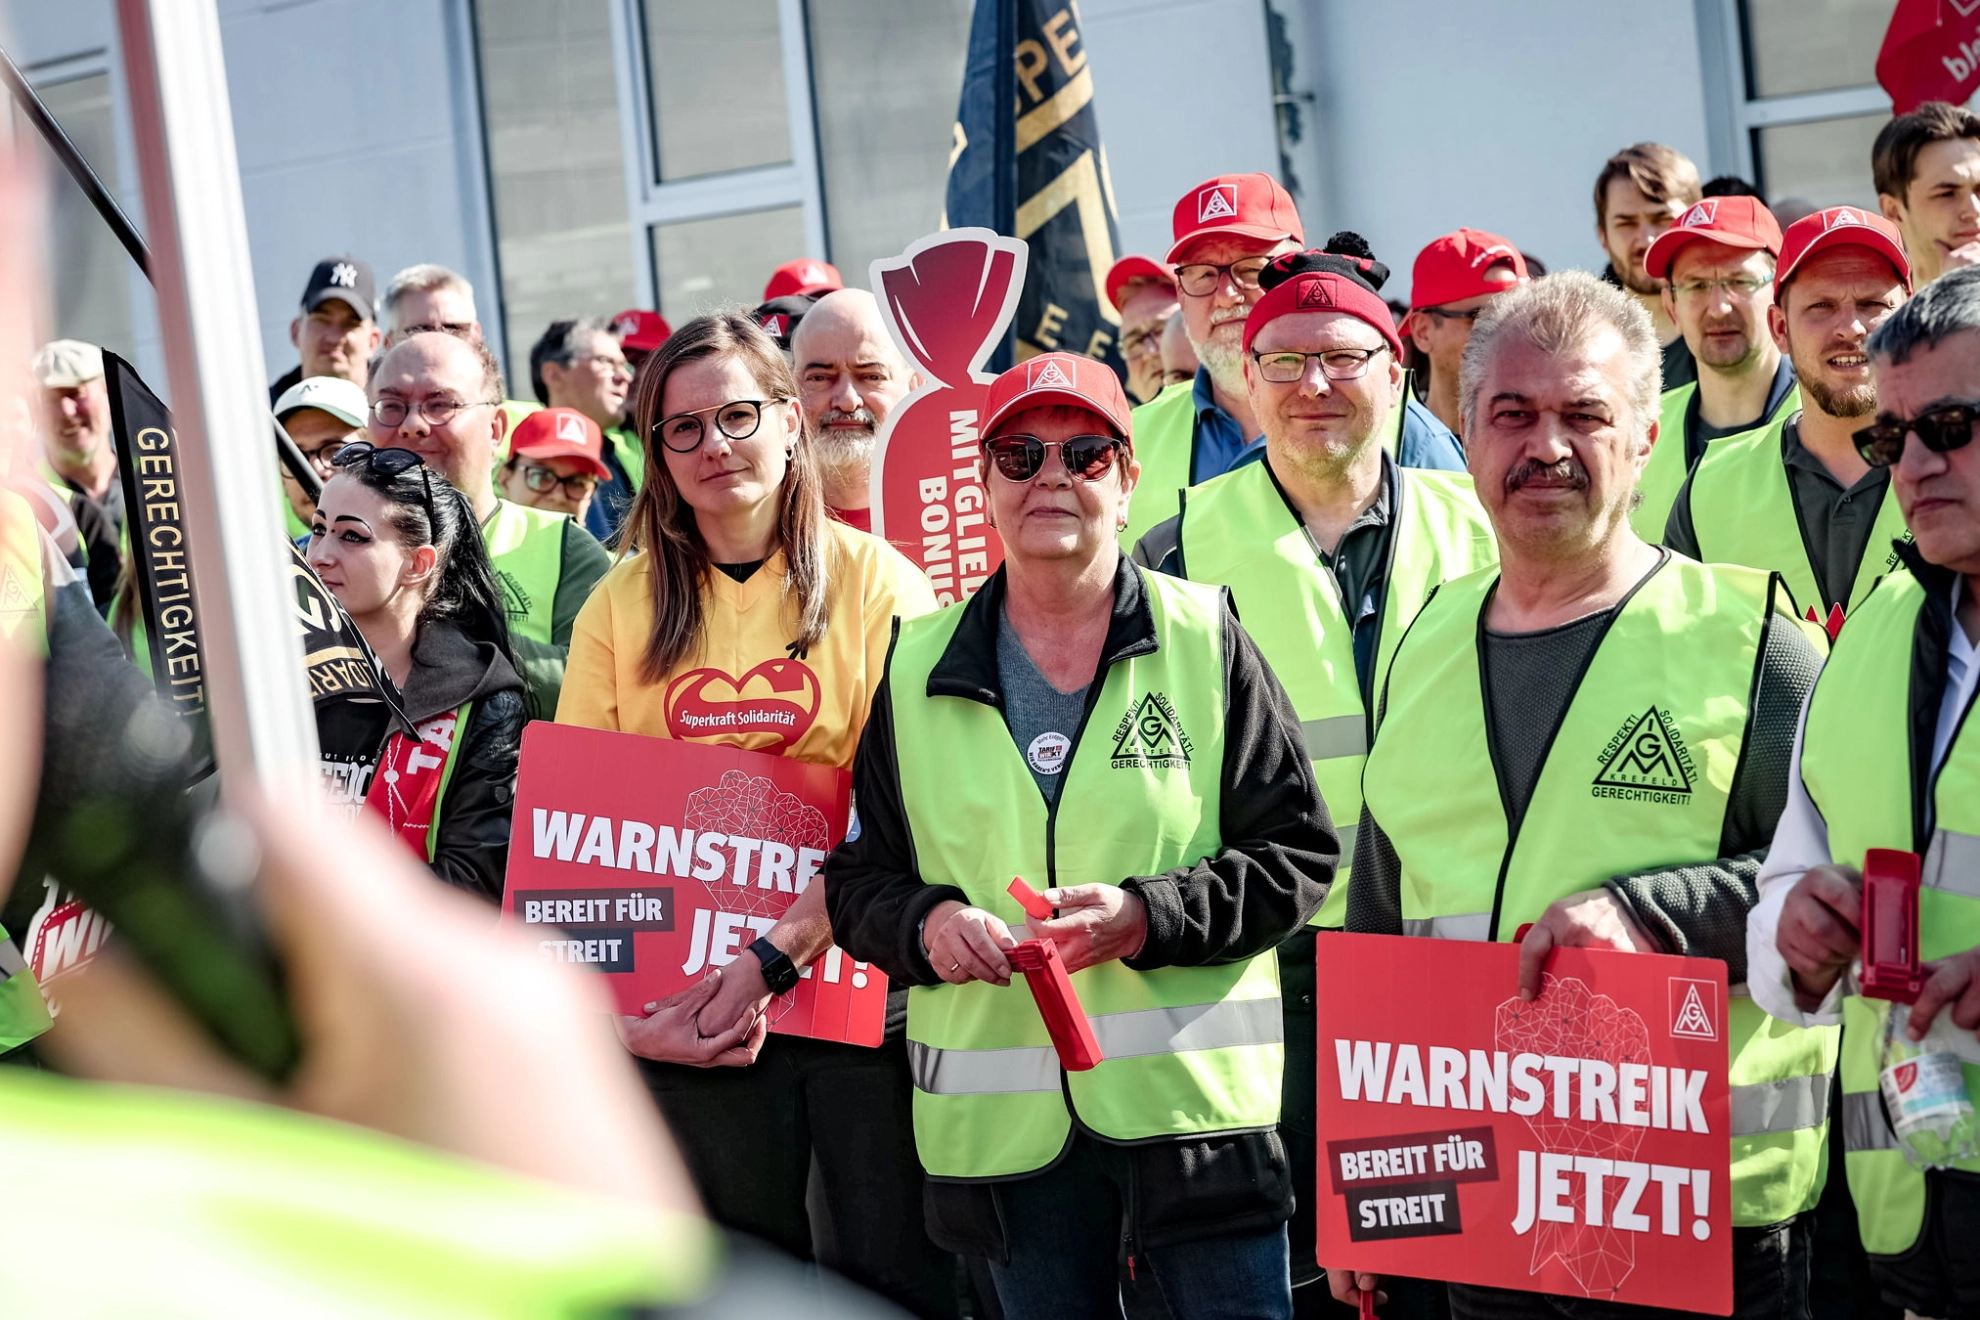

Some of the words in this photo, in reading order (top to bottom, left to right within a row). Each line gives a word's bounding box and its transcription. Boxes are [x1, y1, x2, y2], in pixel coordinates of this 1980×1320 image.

[680, 709, 737, 729] Superkraft
[738, 709, 796, 726] Solidarität
[1112, 699, 1140, 742] RESPEKT!
[1155, 692, 1194, 753] SOLIDARITÄT!
[1597, 714, 1639, 765] RESPEKT!
[1111, 759, 1191, 771] GERECHTIGKEIT!
[1660, 710, 1698, 784] SOLIDARITÄT!
[1592, 786, 1691, 805] GERECHTIGKEIT!
[1610, 773, 1678, 786] KREFELD
[532, 807, 829, 895] WARNSTRE
[525, 899, 610, 924] BEREIT
[615, 892, 664, 922] FÜR
[538, 938, 623, 964] STREIT
[1334, 1039, 1710, 1134] WARNSTREIK
[1340, 1146, 1428, 1181] BEREIT
[1432, 1134, 1487, 1172] FÜR
[1359, 1193, 1446, 1228] STREIT
[1511, 1150, 1711, 1241] JETZT!
